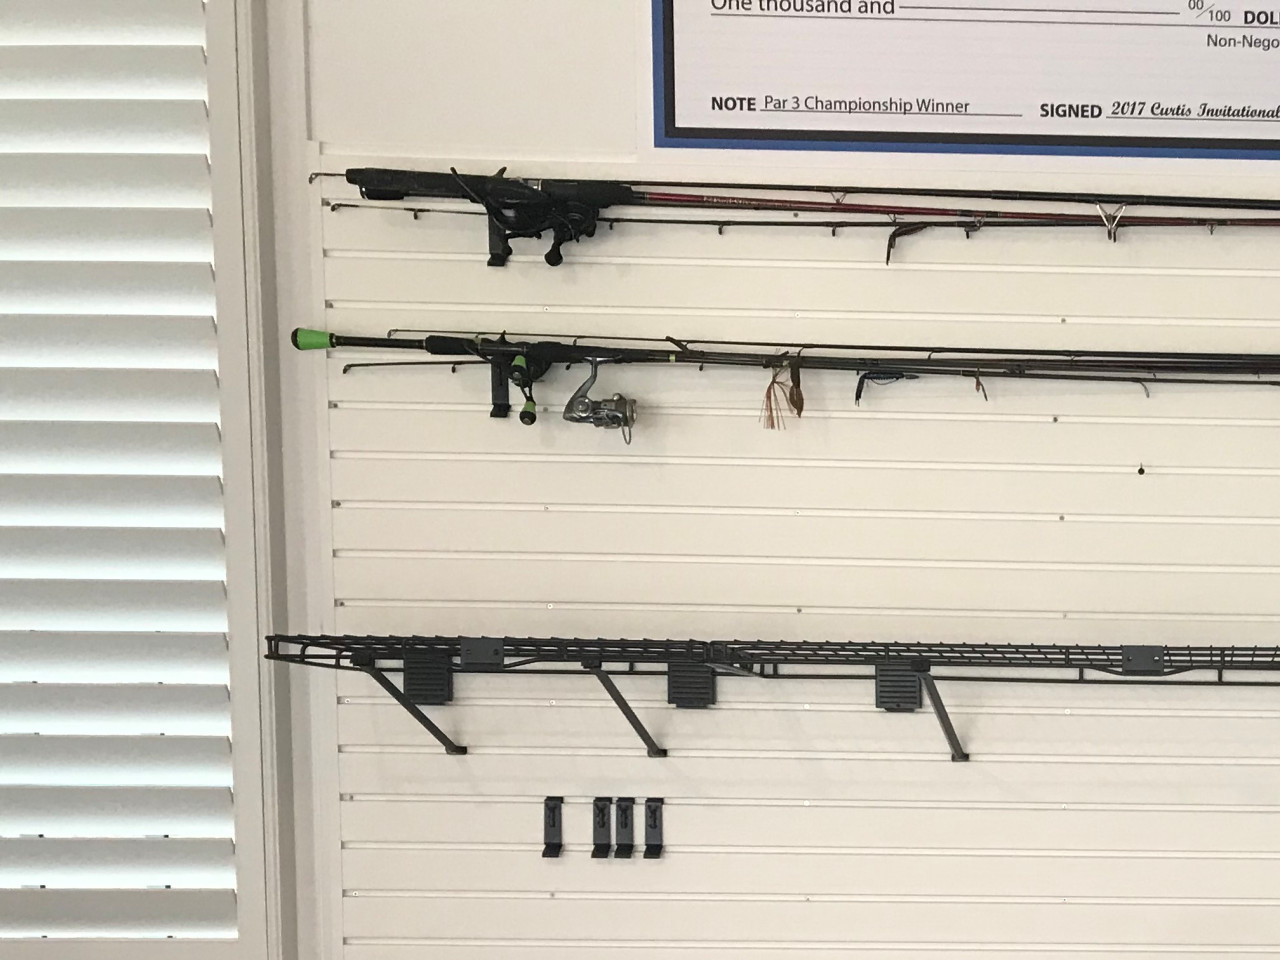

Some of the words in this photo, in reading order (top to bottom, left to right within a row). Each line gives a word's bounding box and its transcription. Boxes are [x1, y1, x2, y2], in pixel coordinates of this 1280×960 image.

[711, 0, 751, 11] One
[759, 0, 851, 13] thousand
[857, 0, 894, 14] and
[711, 96, 757, 112] NOTE
[764, 95, 788, 110] Par
[791, 96, 801, 110] 3
[804, 96, 913, 115] Championship
[916, 98, 970, 114] Winner
[1039, 103, 1103, 118] SIGNED
[1111, 101, 1147, 117] 2017
[1150, 102, 1192, 117] Curtis
